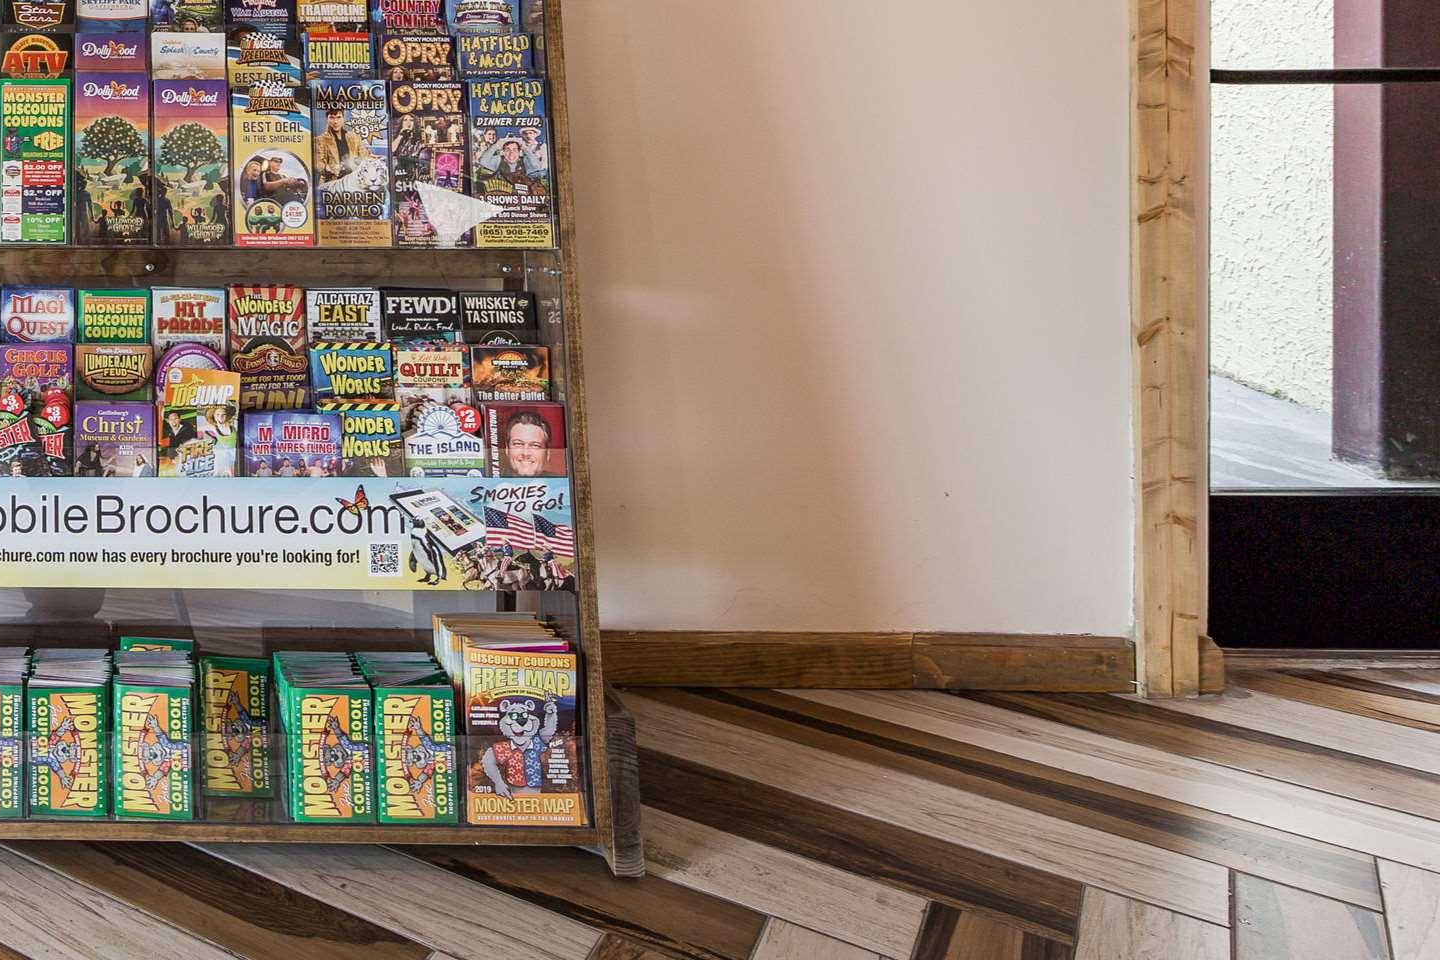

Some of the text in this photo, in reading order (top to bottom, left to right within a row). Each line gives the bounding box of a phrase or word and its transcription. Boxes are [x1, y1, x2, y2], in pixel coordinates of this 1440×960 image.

[299, 4, 366, 16] TRAMPOLINE
[384, 12, 435, 28] TONITE
[253, 41, 282, 49] NASCAR
[309, 42, 370, 62] GATLINBURG
[382, 38, 451, 66] OPRY
[1, 52, 68, 72] ATV
[4, 93, 65, 103] MONSTER
[317, 85, 383, 101] MAGIC
[4, 103, 65, 115] DISCOUNT
[316, 101, 384, 110] BEYOND BELIEF
[4, 117, 64, 127] COUPONS
[243, 122, 303, 132] BEST DEAL
[322, 192, 384, 204] DARREN
[486, 195, 546, 205] SHOWS DAILY
[325, 204, 381, 217] ROMEO
[236, 297, 293, 315] WONDERS
[315, 294, 373, 305] ALCATRAZ
[386, 297, 456, 314] FEWD!
[464, 297, 516, 309] WHISKEY
[85, 304, 144, 313] MONSTER
[175, 302, 206, 317] HIT
[319, 304, 369, 323] EAST
[85, 315, 144, 325] DISCOUNT
[157, 317, 223, 334] PARADE
[466, 311, 525, 324] TASTINGS
[86, 327, 143, 338] COUPONS
[237, 317, 299, 336] MAGIC
[5, 350, 67, 363] CIRCUS
[320, 351, 386, 375] WONDER
[12, 364, 59, 378] GOLF
[85, 353, 146, 378] LUMBERJACK
[104, 368, 127, 377] FEUD
[400, 363, 460, 377] QUILT
[331, 374, 381, 395] WORKS
[241, 388, 305, 409] FUN!
[284, 425, 330, 441] MICRO
[408, 442, 480, 454] THE ISLAND
[470, 485, 548, 504] SMOKIES
[504, 493, 563, 513] TO GO!
[69, 551, 97, 562] now
[102, 549, 126, 563] has
[130, 551, 167, 565] every
[171, 549, 232, 563] brochure
[236, 549, 278, 566] you're
[282, 549, 333, 566] looking
[337, 549, 360, 563] for!
[471, 652, 570, 668] DISCOUNT COUPONS
[470, 667, 570, 697] FREE MAP
[2, 695, 13, 736] BOOK
[37, 697, 49, 757] COUPON
[206, 672, 244, 790] MONSTER
[60, 695, 97, 808] MONSTER
[252, 727, 264, 789] COUPON
[383, 697, 424, 817] MONSTER
[1, 747, 13, 809] COUPON
[38, 766, 49, 806] BOOK
[434, 752, 446, 815] COUPON
[475, 798, 575, 813] MONSTER MAP
